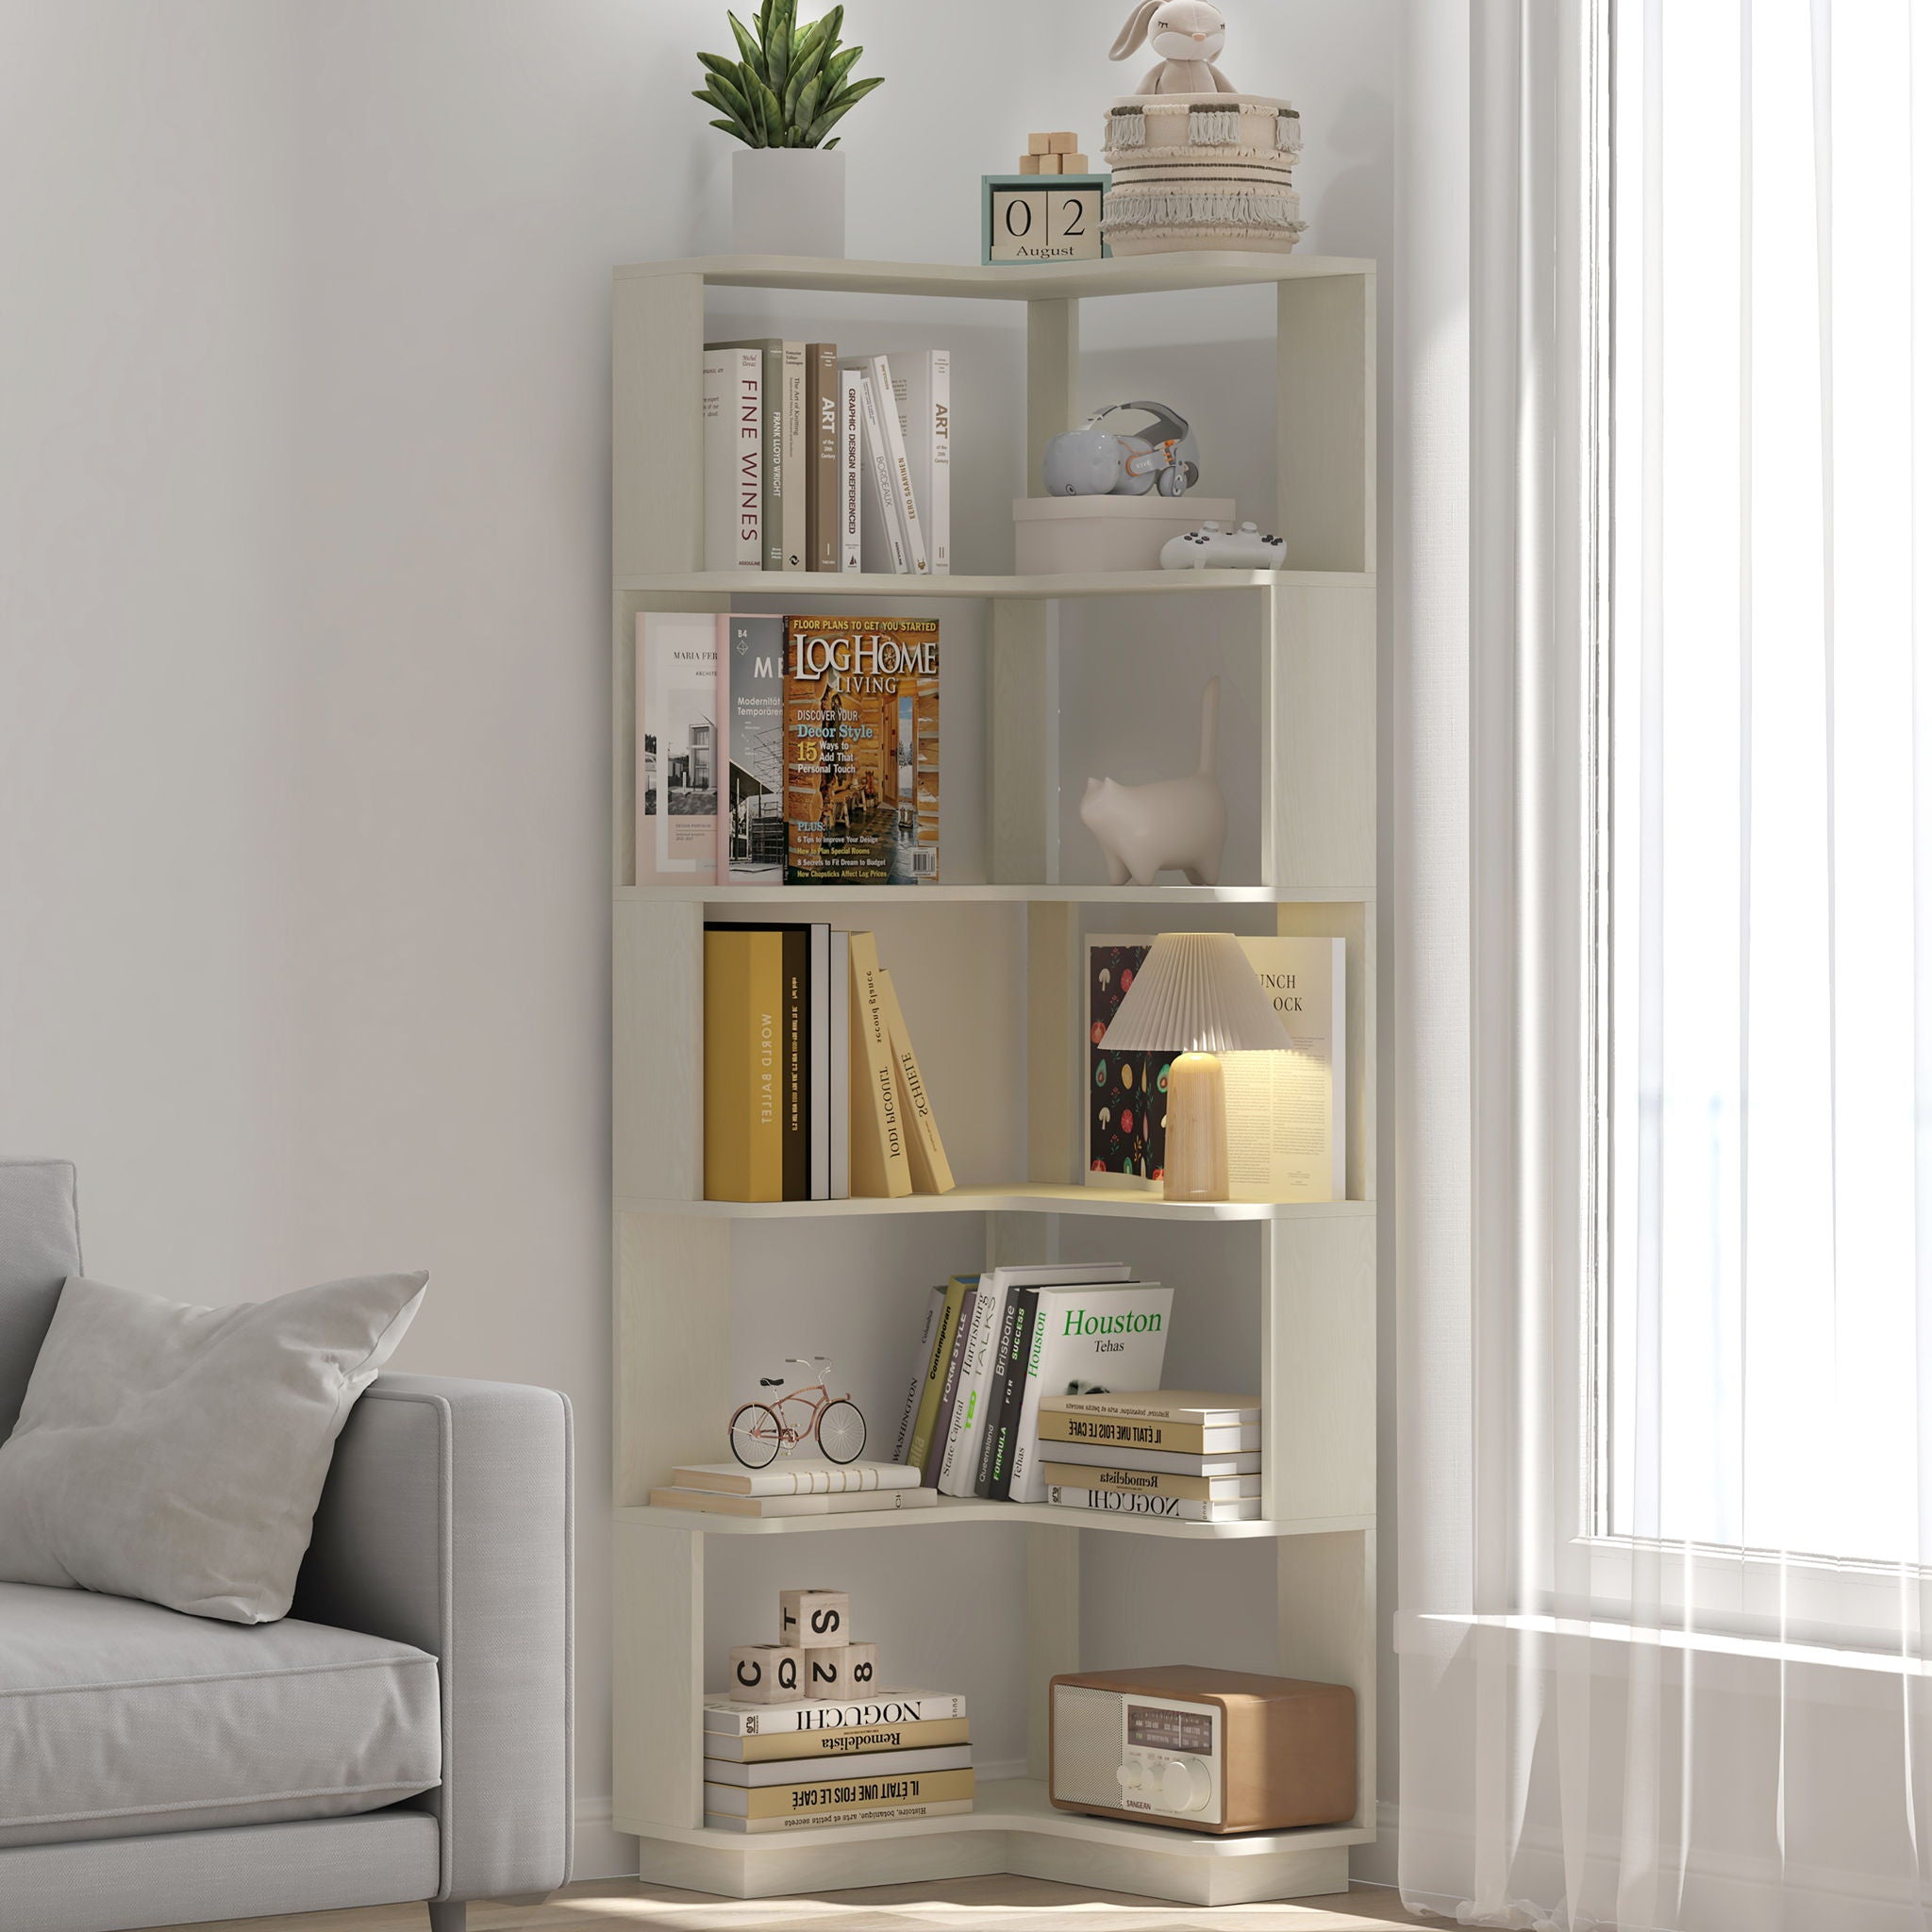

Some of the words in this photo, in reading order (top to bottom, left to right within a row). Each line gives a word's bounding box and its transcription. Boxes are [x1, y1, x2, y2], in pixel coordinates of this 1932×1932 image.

[1062, 199, 1086, 236] 2
[1016, 245, 1075, 259] August
[741, 380, 758, 439] FINE
[822, 397, 836, 434] ART
[935, 403, 948, 439] ART
[773, 411, 781, 438] FRANK
[773, 439, 781, 464] LLOYD
[773, 465, 781, 497] WRIGHT
[875, 456, 893, 508] BORDEAUX
[898, 458, 911, 497] SAARINEN
[741, 453, 758, 541] WINES
[906, 499, 916, 520] EERO
[793, 620, 820, 629] FLOOR
[823, 621, 848, 630] PLANS
[852, 621, 862, 630] TO
[864, 621, 879, 630] GET
[882, 622, 898, 631] YOU
[901, 622, 937, 631] STARTED
[674, 651, 700, 660] MARIA
[837, 676, 897, 694] LIVING
[797, 709, 836, 721] DISCOVER
[838, 709, 858, 722] YOUR
[796, 724, 836, 738] Decor
[839, 724, 874, 741] Style
[797, 741, 818, 762] 15
[819, 741, 839, 751] Ways
[841, 741, 849, 750] to
[819, 752, 835, 762] Add
[836, 752, 854, 762] That
[797, 764, 831, 774] Personal
[833, 764, 856, 774] Touch
[797, 822, 826, 832] PLUS:
[823, 836, 844, 844] Improve
[859, 836, 878, 844] Design
[921, 1309, 933, 1344] Columbia
[962, 1292, 989, 1376] Harrisburg
[1062, 1308, 1162, 1337] Houston
[995, 1305, 1015, 1376] Brisbane
[1027, 1311, 1046, 1378] Houston
[1094, 1340, 1124, 1353] Tehas
[943, 1362, 957, 1403] FORM
[952, 1312, 967, 1358] STYLE
[964, 1390, 977, 1431] TED
[975, 1296, 996, 1376] TALKS
[992, 1426, 1007, 1481] FORMULA
[1005, 1379, 1013, 1404] FOR
[1011, 1307, 1024, 1360] SUCCESS
[892, 1377, 919, 1462] WASHINGTON
[943, 1445, 955, 1477] State
[951, 1399, 964, 1443] Capital
[978, 1424, 994, 1483] Queensland
[1012, 1446, 1024, 1479] Tehas
[784, 1607, 796, 1631] T
[811, 1609, 840, 1634] S
[737, 1660, 761, 1687] C
[778, 1657, 797, 1690] Q
[812, 1661, 837, 1683] 2
[854, 1661, 873, 1683] 8
[796, 1701, 922, 1731] NOGUCHI
[822, 1732, 901, 1751] Remodelista
[820, 1788, 832, 1805] LE
[834, 1786, 857, 1804] FOIS
[858, 1784, 878, 1801] UNE
[880, 1782, 908, 1801] ÉTAIT
[909, 1780, 920, 1796] IL
[792, 1790, 818, 1810] CAFÉ
[896, 1807, 926, 1816] Histoire,
[1126, 1799, 1152, 1810] SANGEAN
[784, 1818, 810, 1826] secrets
[812, 1816, 832, 1824] petits
[858, 1809, 894, 1819] botanique,
